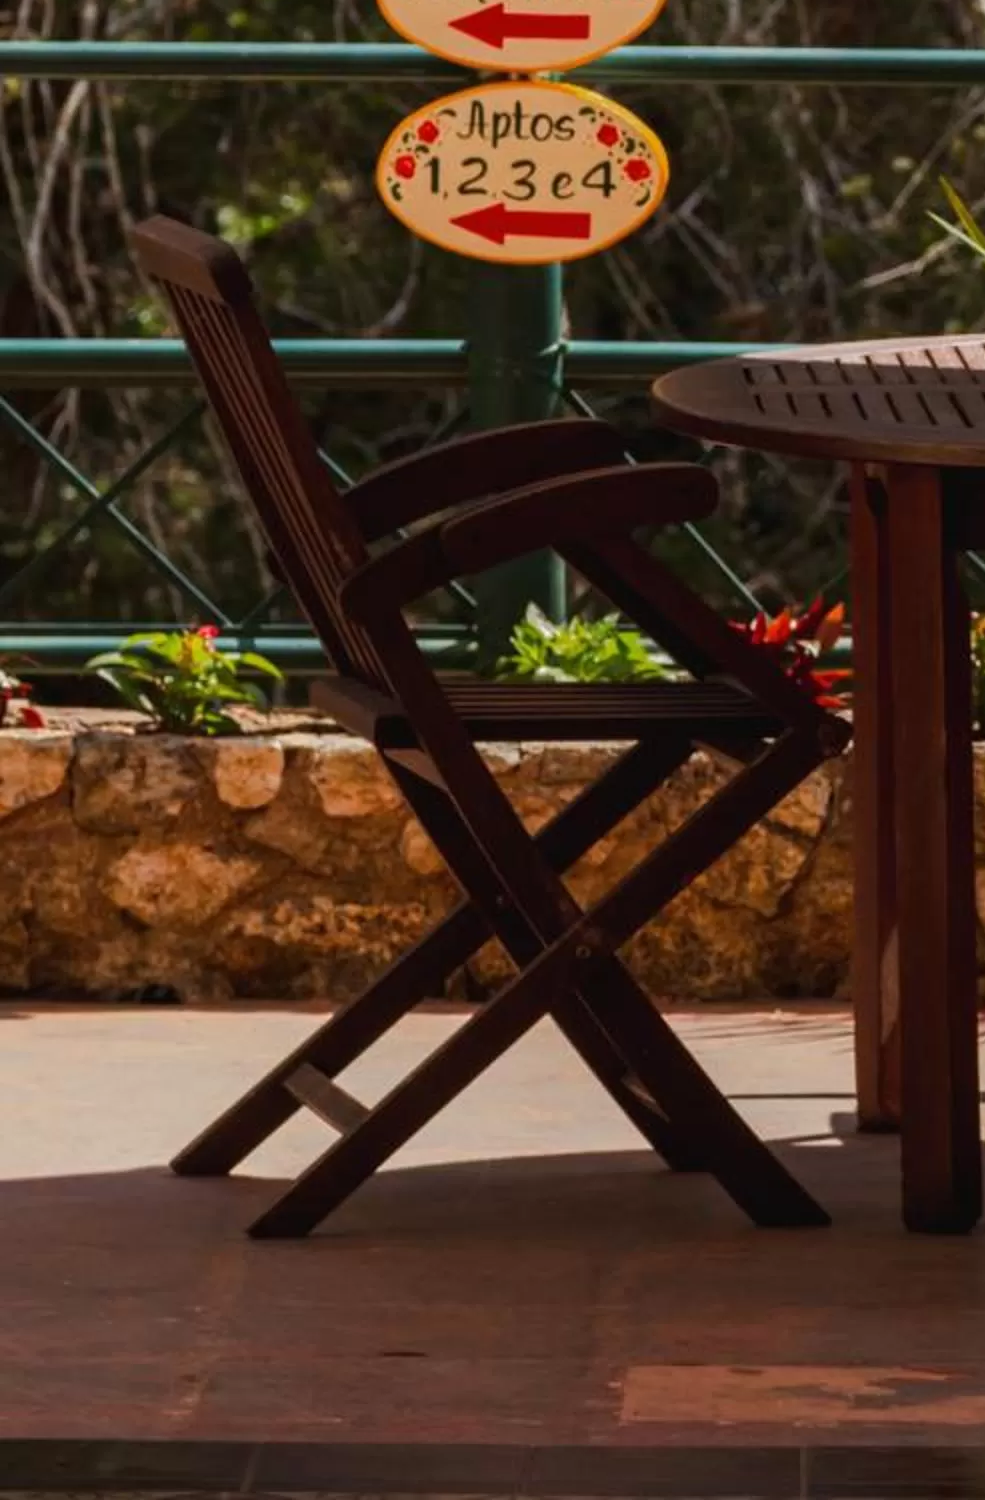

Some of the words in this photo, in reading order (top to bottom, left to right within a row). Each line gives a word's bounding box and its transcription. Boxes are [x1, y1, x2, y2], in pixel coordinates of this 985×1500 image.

[455, 99, 576, 149] Aptos
[551, 171, 575, 201] e
[581, 160, 618, 199] 4
